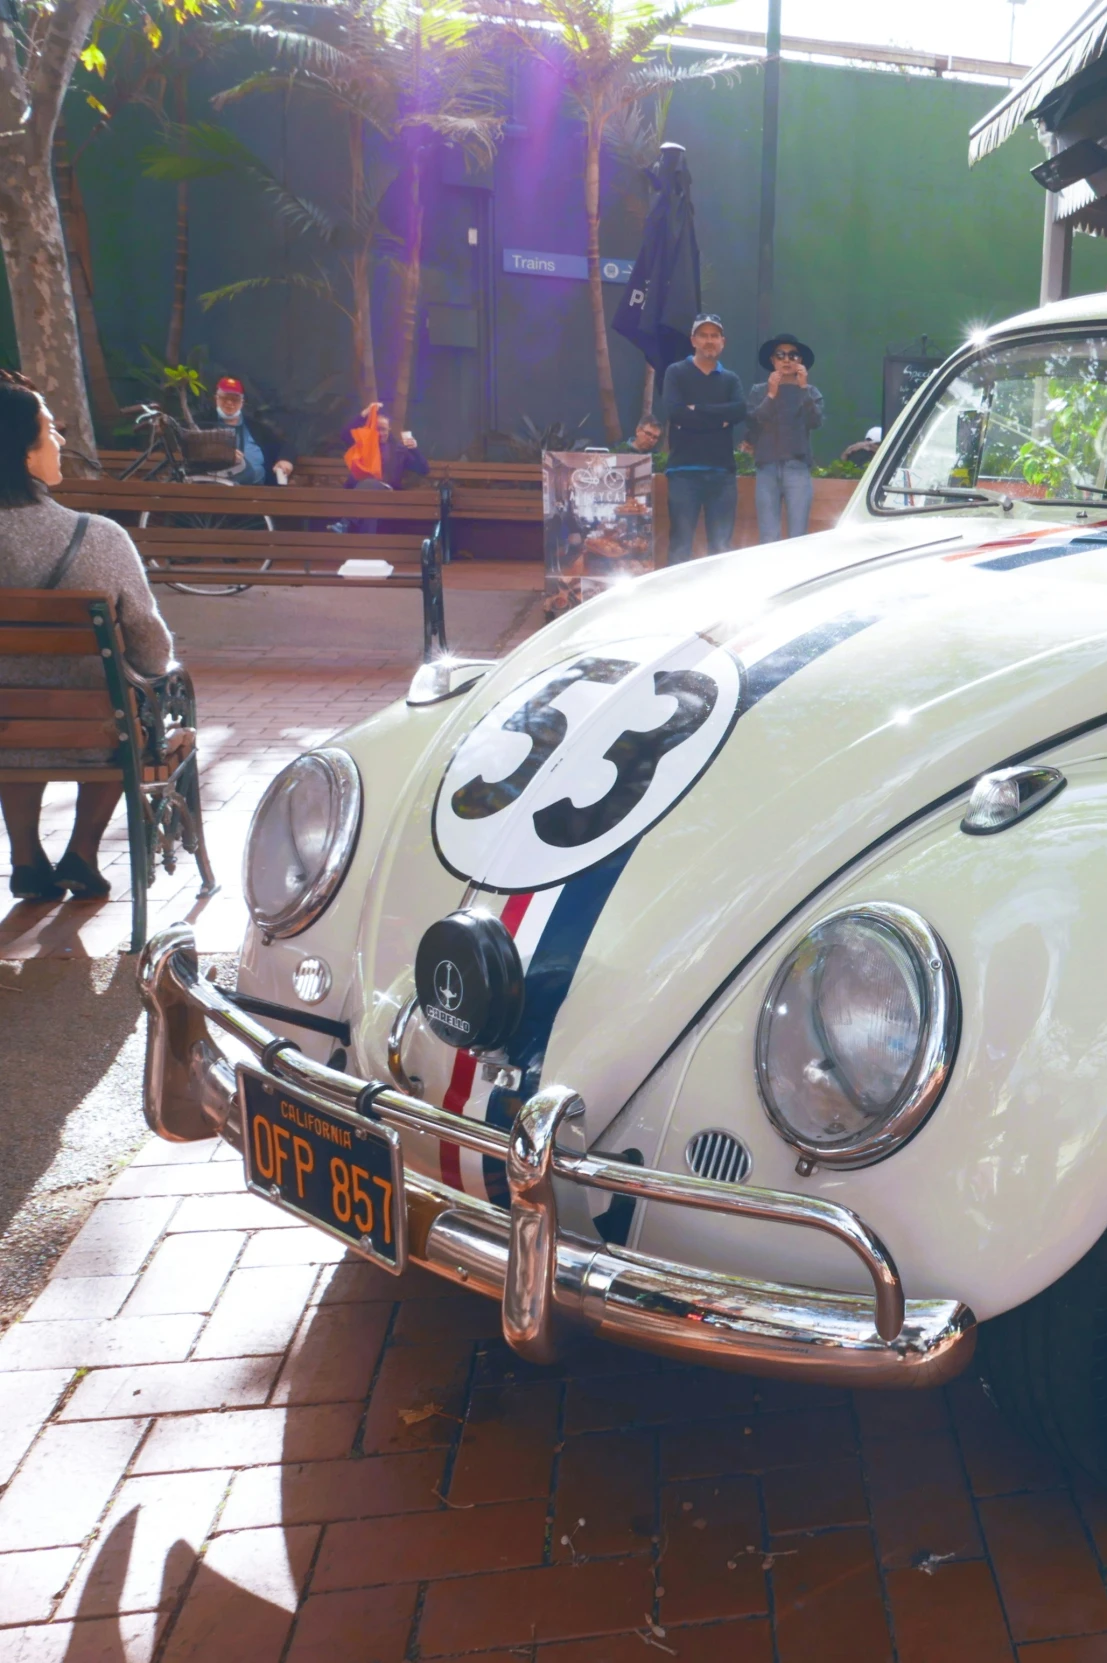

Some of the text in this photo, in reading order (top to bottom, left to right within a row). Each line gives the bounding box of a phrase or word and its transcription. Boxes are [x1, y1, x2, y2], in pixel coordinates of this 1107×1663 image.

[511, 254, 556, 272] Trains
[451, 656, 719, 848] 53
[426, 1004, 471, 1034] CARELLO
[280, 1100, 352, 1150] CALIFORNIA
[253, 1114, 393, 1244] OFP 857
